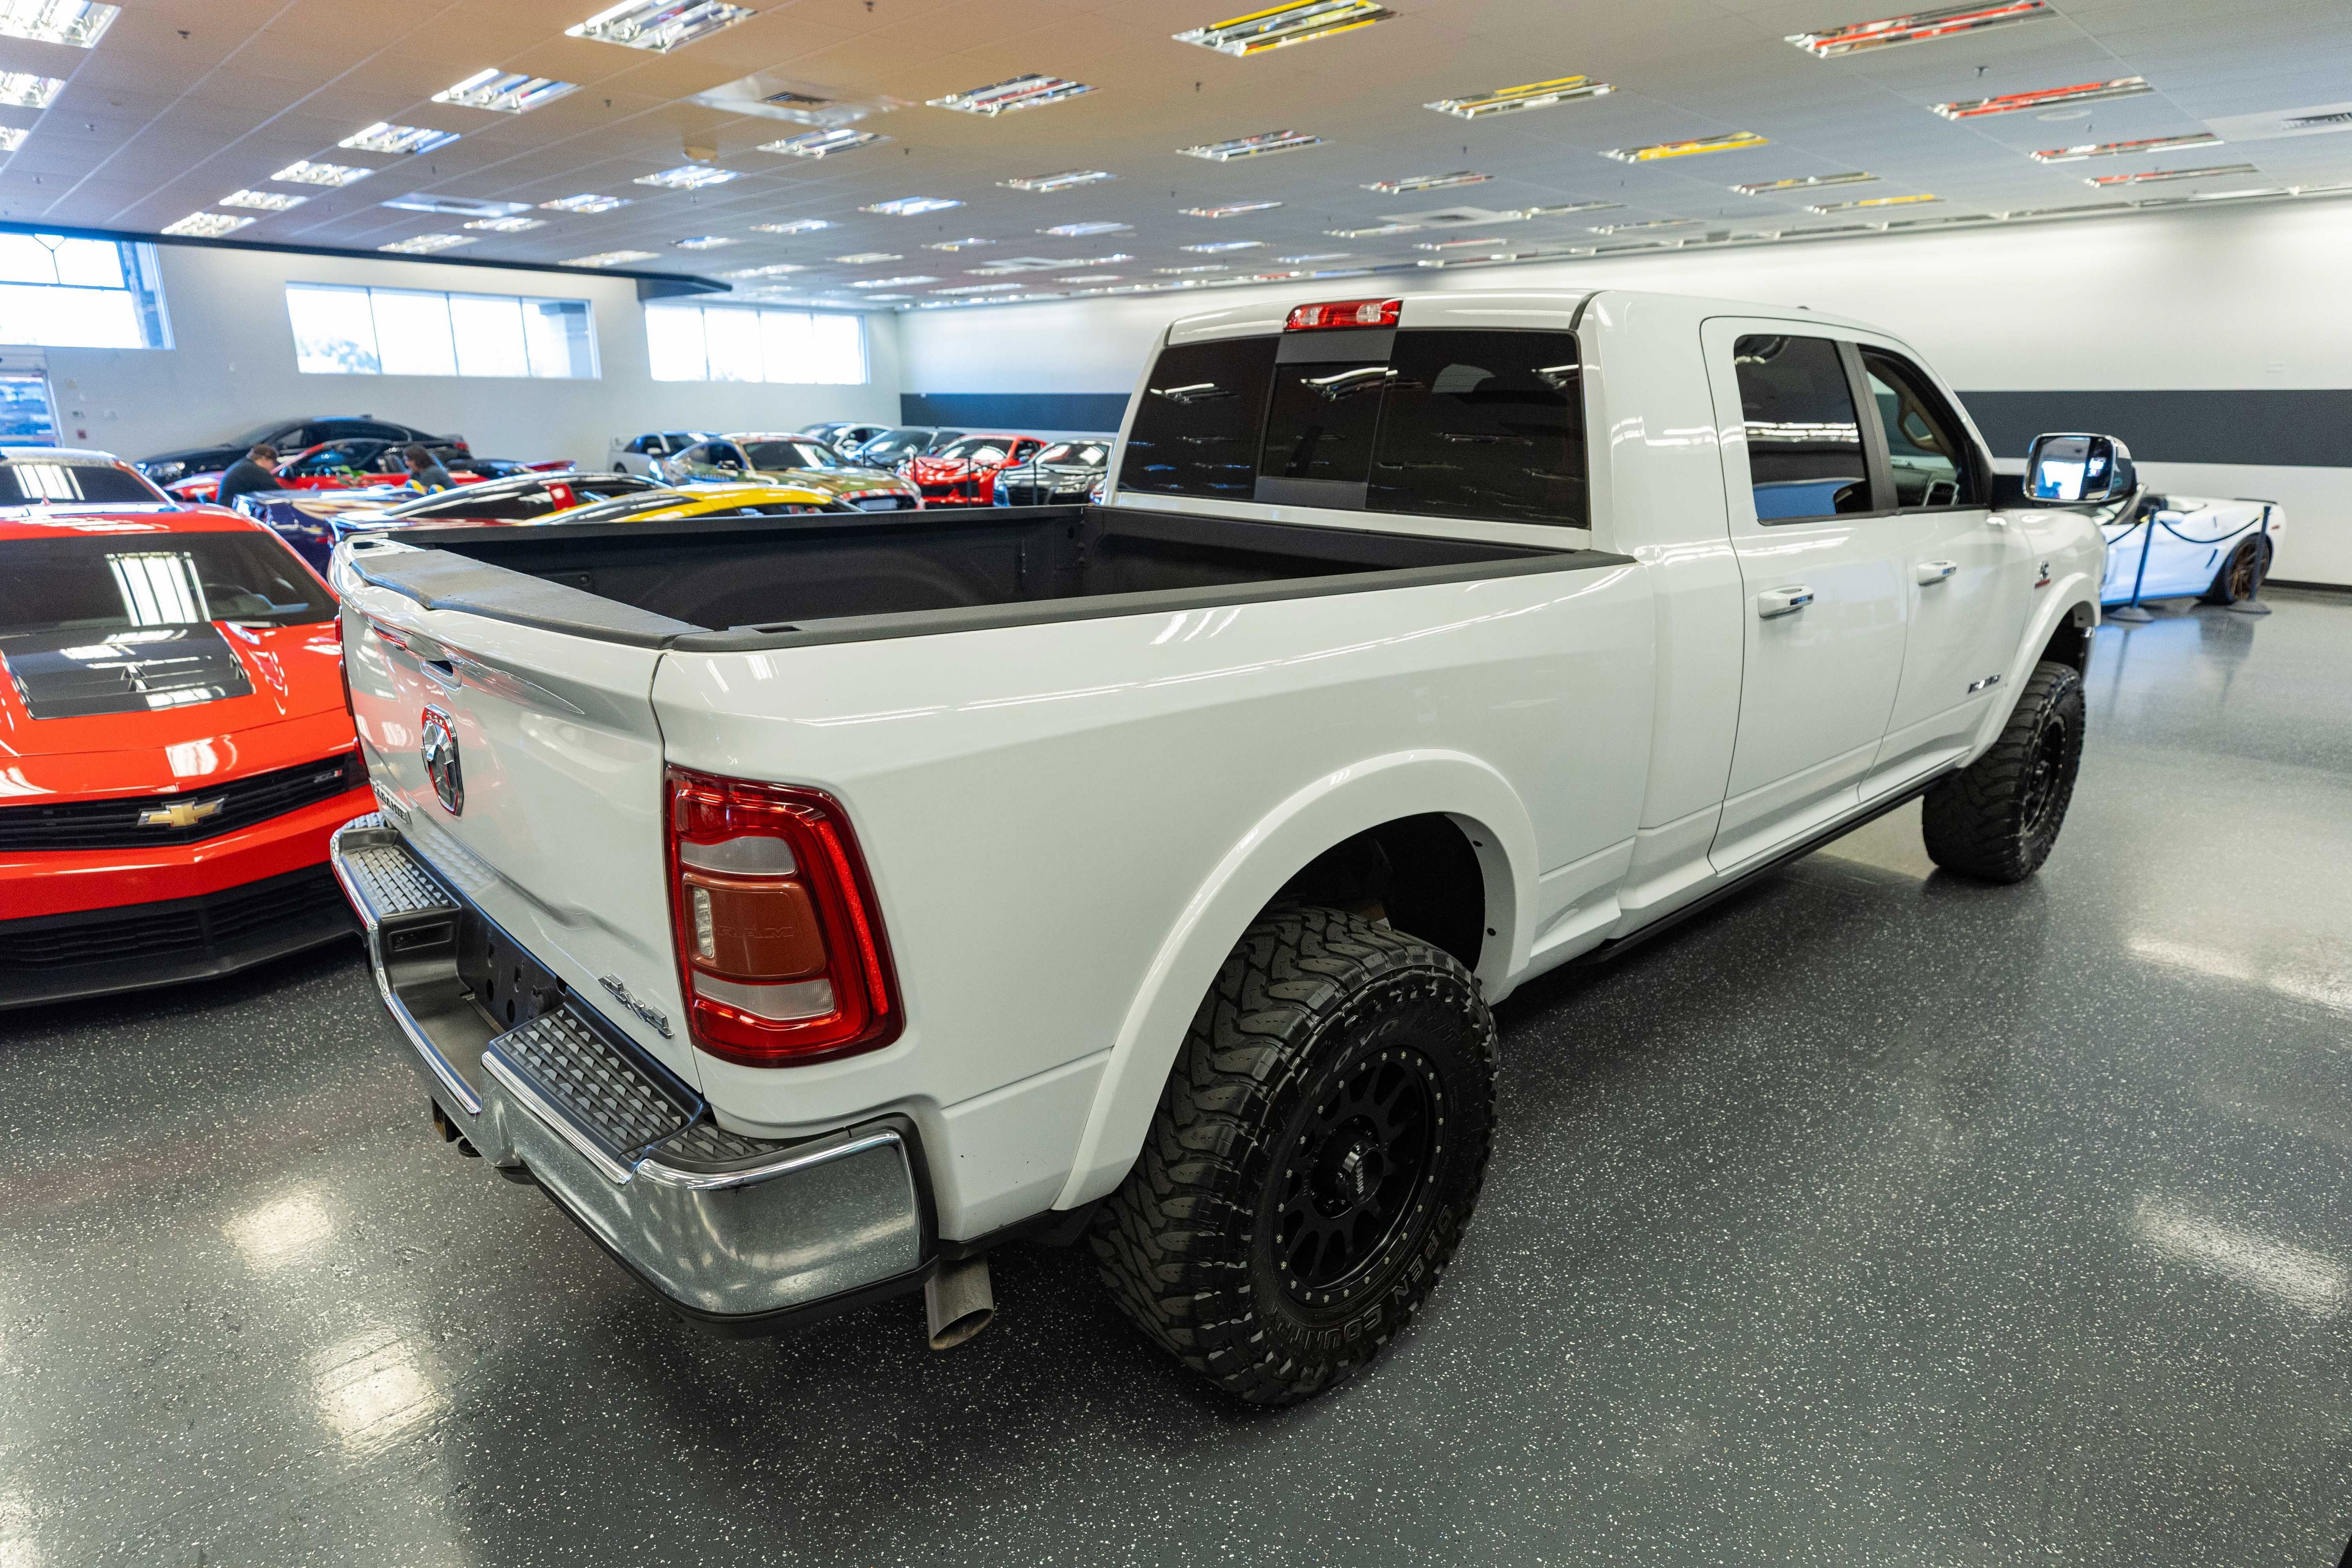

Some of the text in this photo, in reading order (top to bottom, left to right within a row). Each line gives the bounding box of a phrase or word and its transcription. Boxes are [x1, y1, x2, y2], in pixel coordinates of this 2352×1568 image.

[372, 781, 407, 822] LARAMIE
[717, 925, 794, 939] RAM
[1310, 1016, 1401, 1098] TOYO
[1355, 1160, 1364, 1195] ETHOD
[1391, 1205, 1454, 1305] OPEN
